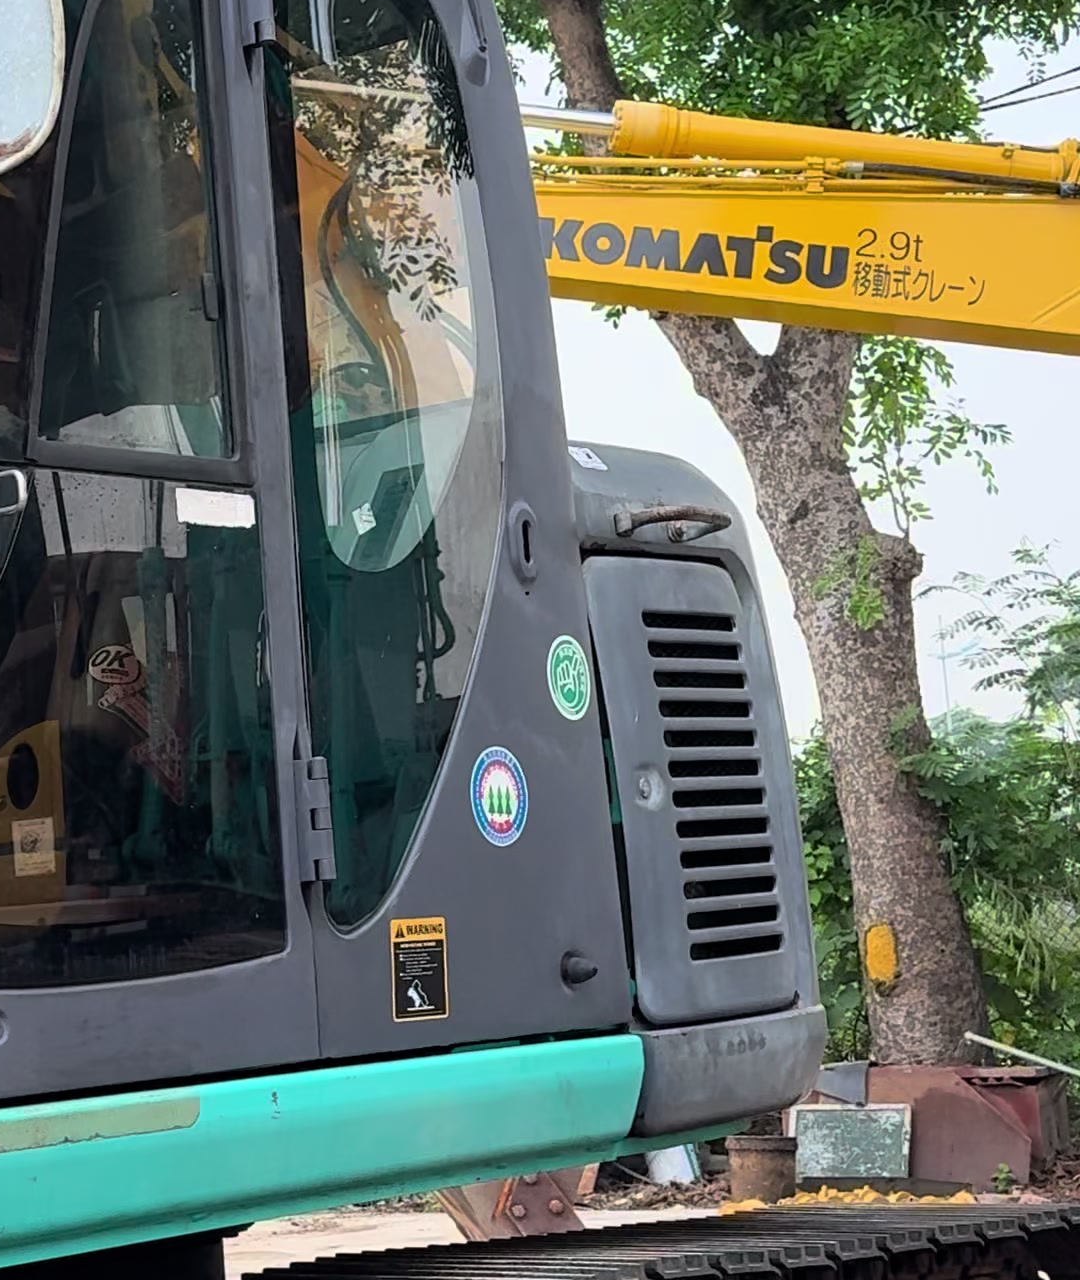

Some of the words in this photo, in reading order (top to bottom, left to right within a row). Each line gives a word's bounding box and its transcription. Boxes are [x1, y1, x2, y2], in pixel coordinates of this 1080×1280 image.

[539, 217, 849, 289] KOMATSU
[855, 228, 924, 263] 2.9t
[853, 261, 985, 306] 移動式クレーン
[91, 650, 133, 668] OK
[406, 923, 445, 936] WARNING
